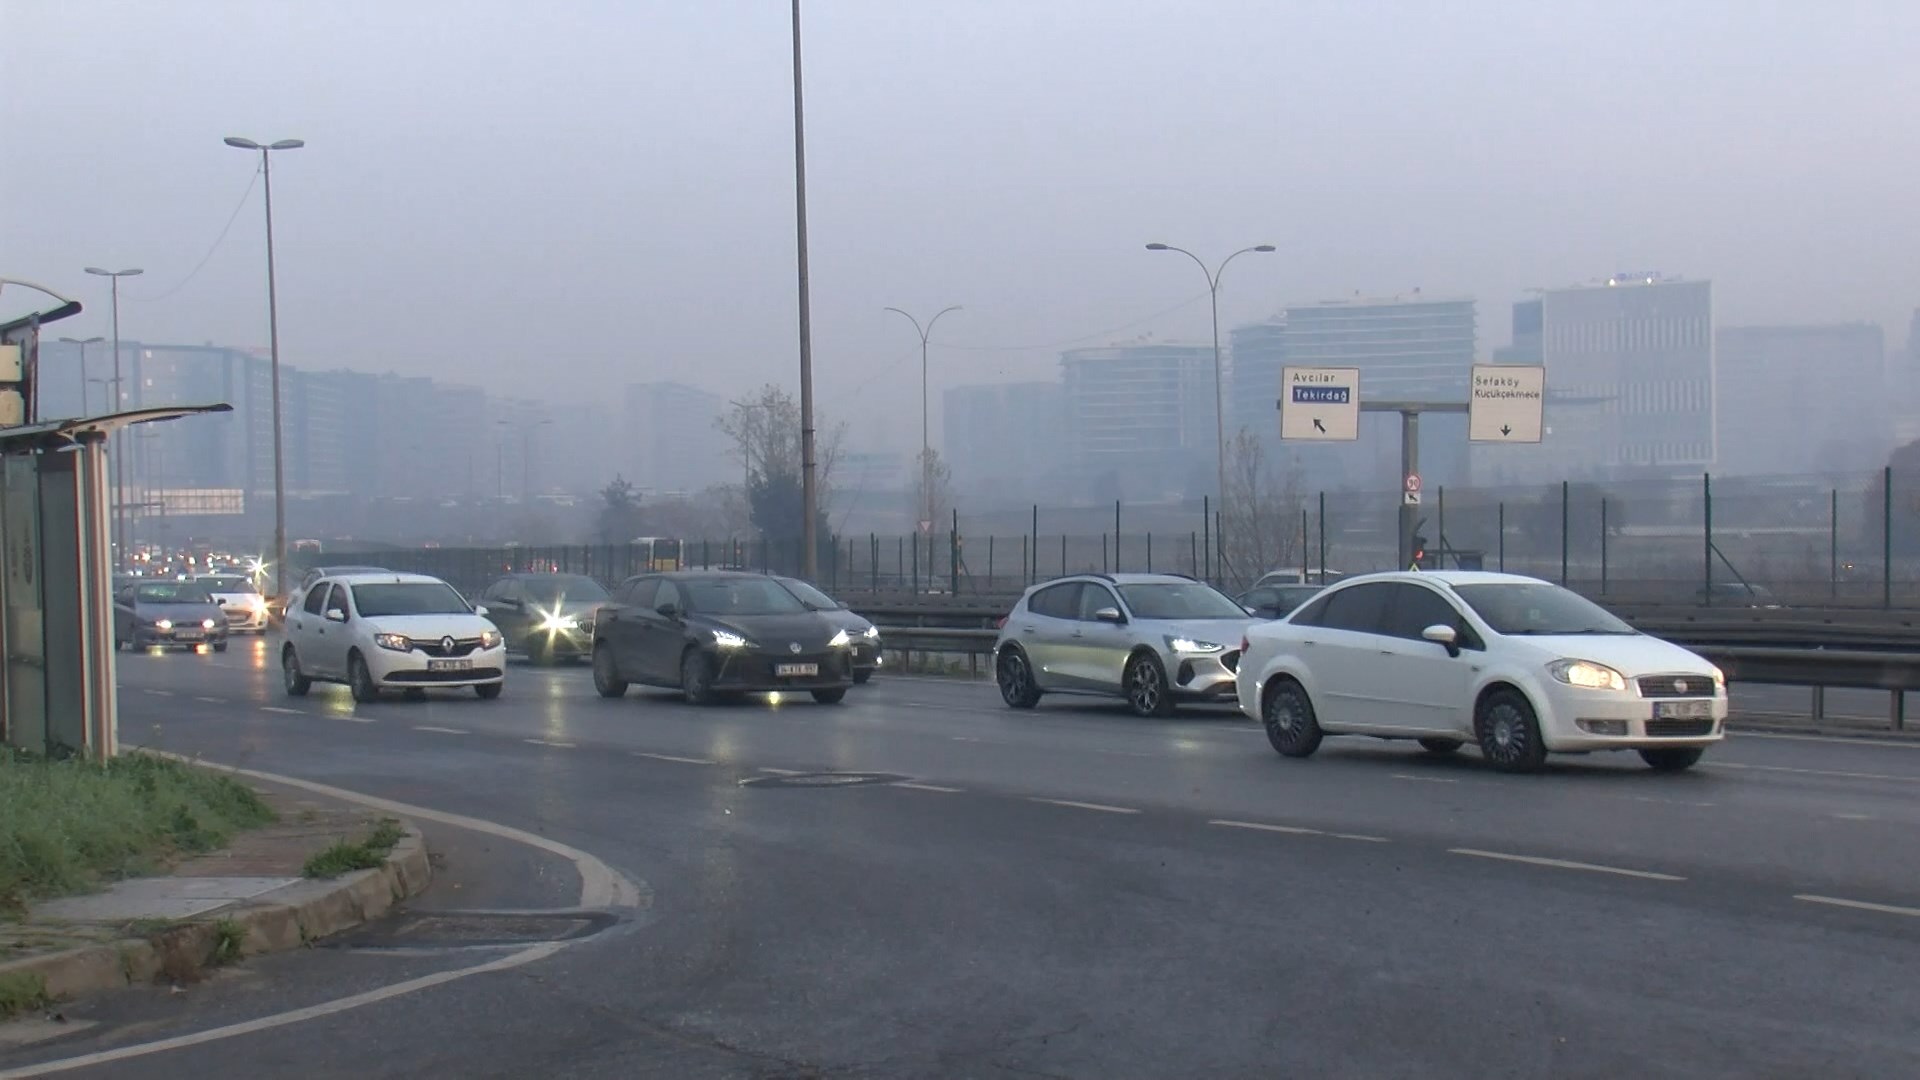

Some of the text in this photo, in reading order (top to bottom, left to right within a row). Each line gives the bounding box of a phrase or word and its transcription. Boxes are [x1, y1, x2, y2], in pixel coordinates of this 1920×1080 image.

[1293, 373, 1336, 382] Avcılar
[1475, 375, 1519, 388] Sefaköy
[1296, 389, 1348, 403] Tekirdağ
